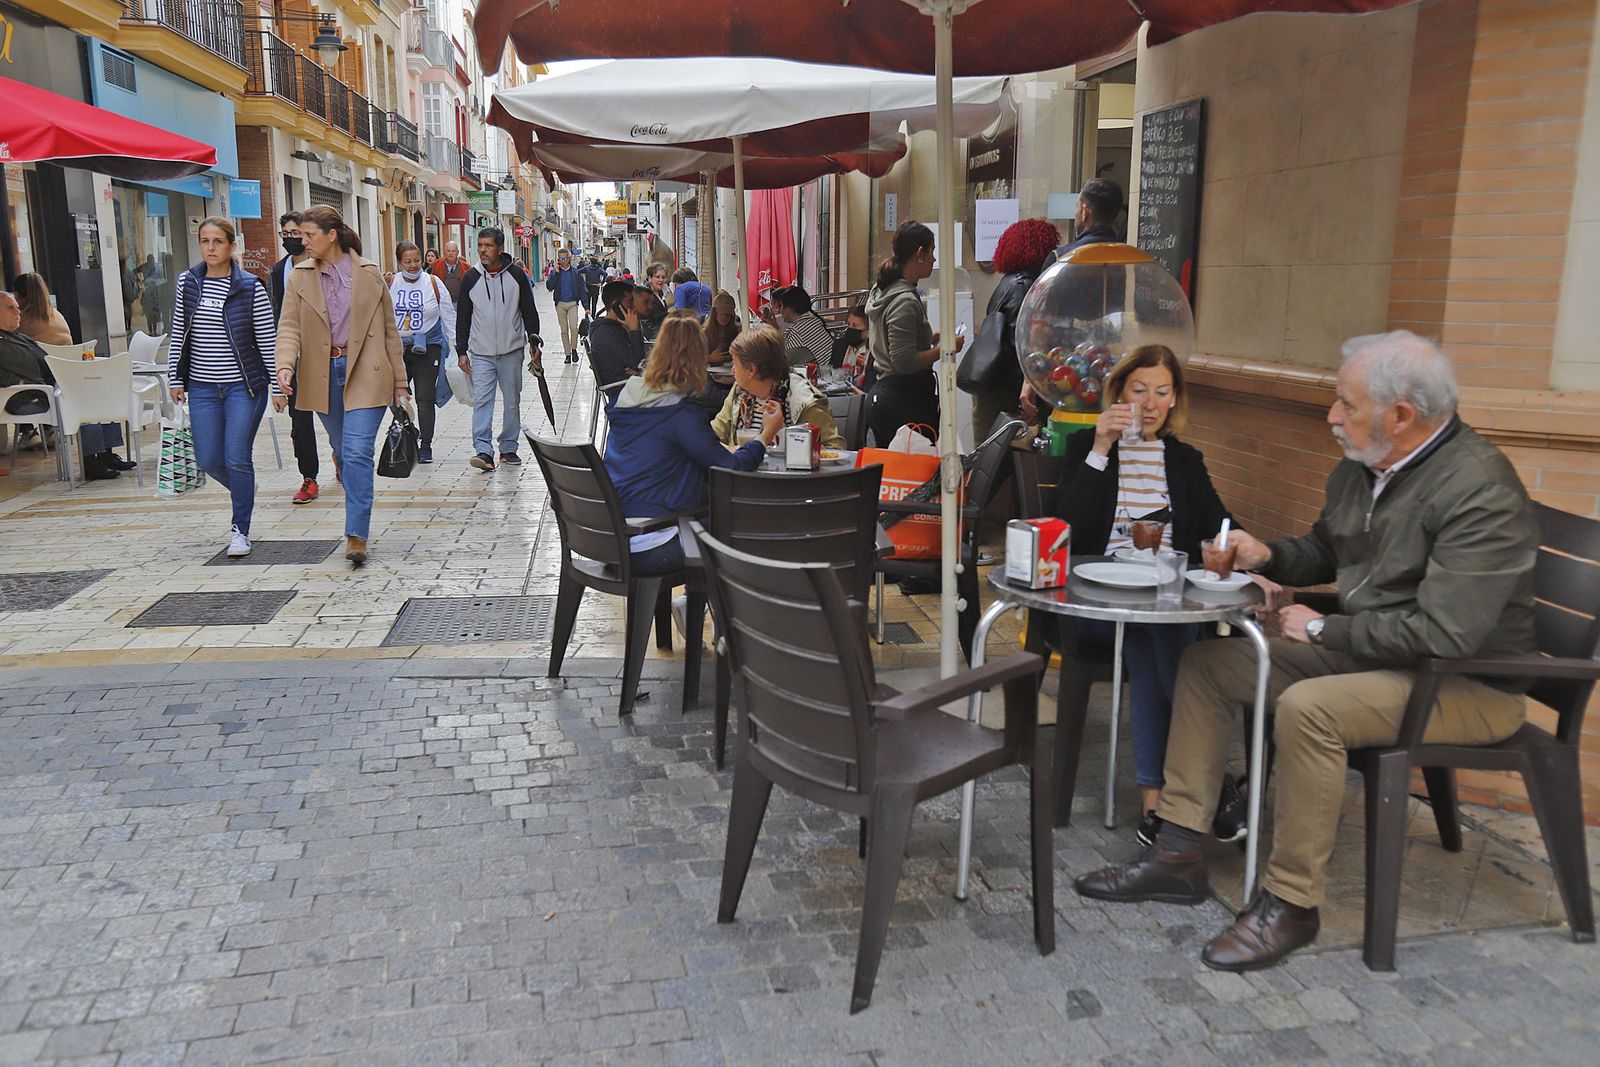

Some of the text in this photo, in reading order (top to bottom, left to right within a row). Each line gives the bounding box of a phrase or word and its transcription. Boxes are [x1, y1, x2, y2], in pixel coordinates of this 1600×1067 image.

[630, 122, 669, 138] Coca-Cola
[396, 289, 424, 309] 19
[394, 309, 424, 331] 78
